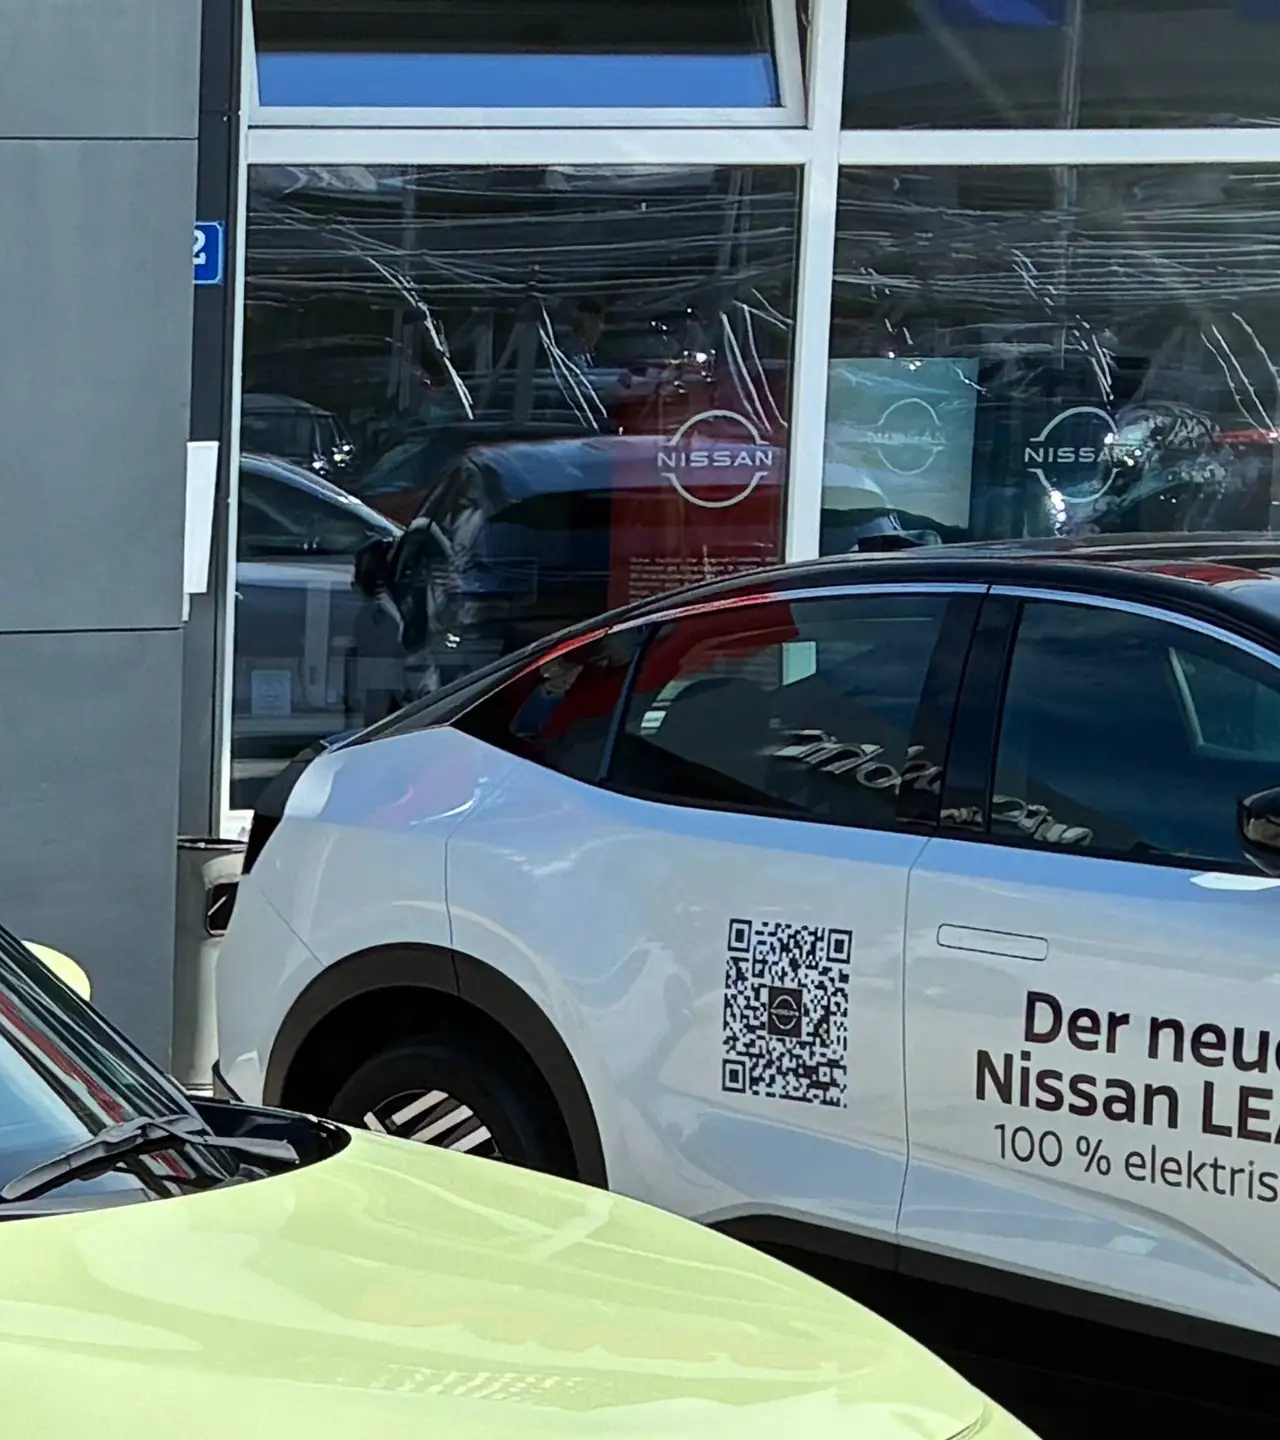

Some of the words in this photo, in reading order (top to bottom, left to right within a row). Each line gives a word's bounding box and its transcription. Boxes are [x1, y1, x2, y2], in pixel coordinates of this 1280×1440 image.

[658, 451, 772, 467] NISSAN
[1024, 990, 1130, 1053] Der
[1148, 1016, 1280, 1073] neu
[976, 1049, 1179, 1129] Nissan
[1202, 1080, 1280, 1144] LE
[994, 1124, 1062, 1167] 100
[1076, 1136, 1111, 1176] %
[1125, 1144, 1279, 1203] elektris
